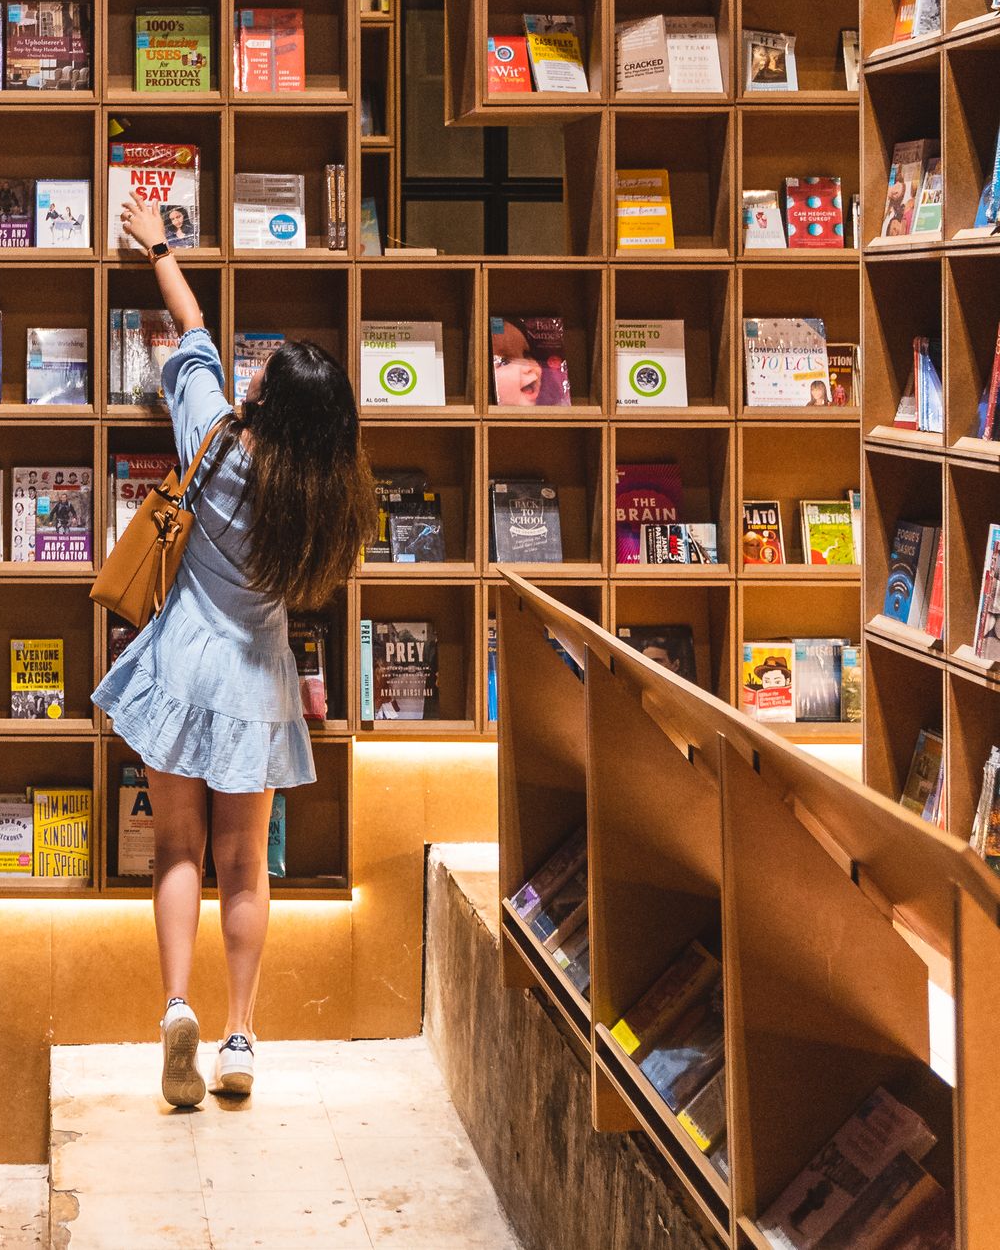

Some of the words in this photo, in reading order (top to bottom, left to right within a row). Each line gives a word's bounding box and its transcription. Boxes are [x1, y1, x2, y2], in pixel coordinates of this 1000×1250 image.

[146, 20, 184, 32] 1000's
[624, 58, 664, 71] CRACKED
[130, 170, 176, 186] NEW
[135, 187, 169, 203] SAT
[363, 332, 394, 341] TRUTH
[396, 332, 411, 340] TO
[616, 508, 677, 521] BRAIN
[808, 514, 849, 523] GENETICS
[44, 541, 65, 551] MAPS
[67, 541, 84, 551] AND
[16, 650, 59, 662] EVERYONE
[386, 642, 425, 662] PREY
[17, 671, 59, 684] RACISM
[43, 823, 88, 847] KINGDOM
